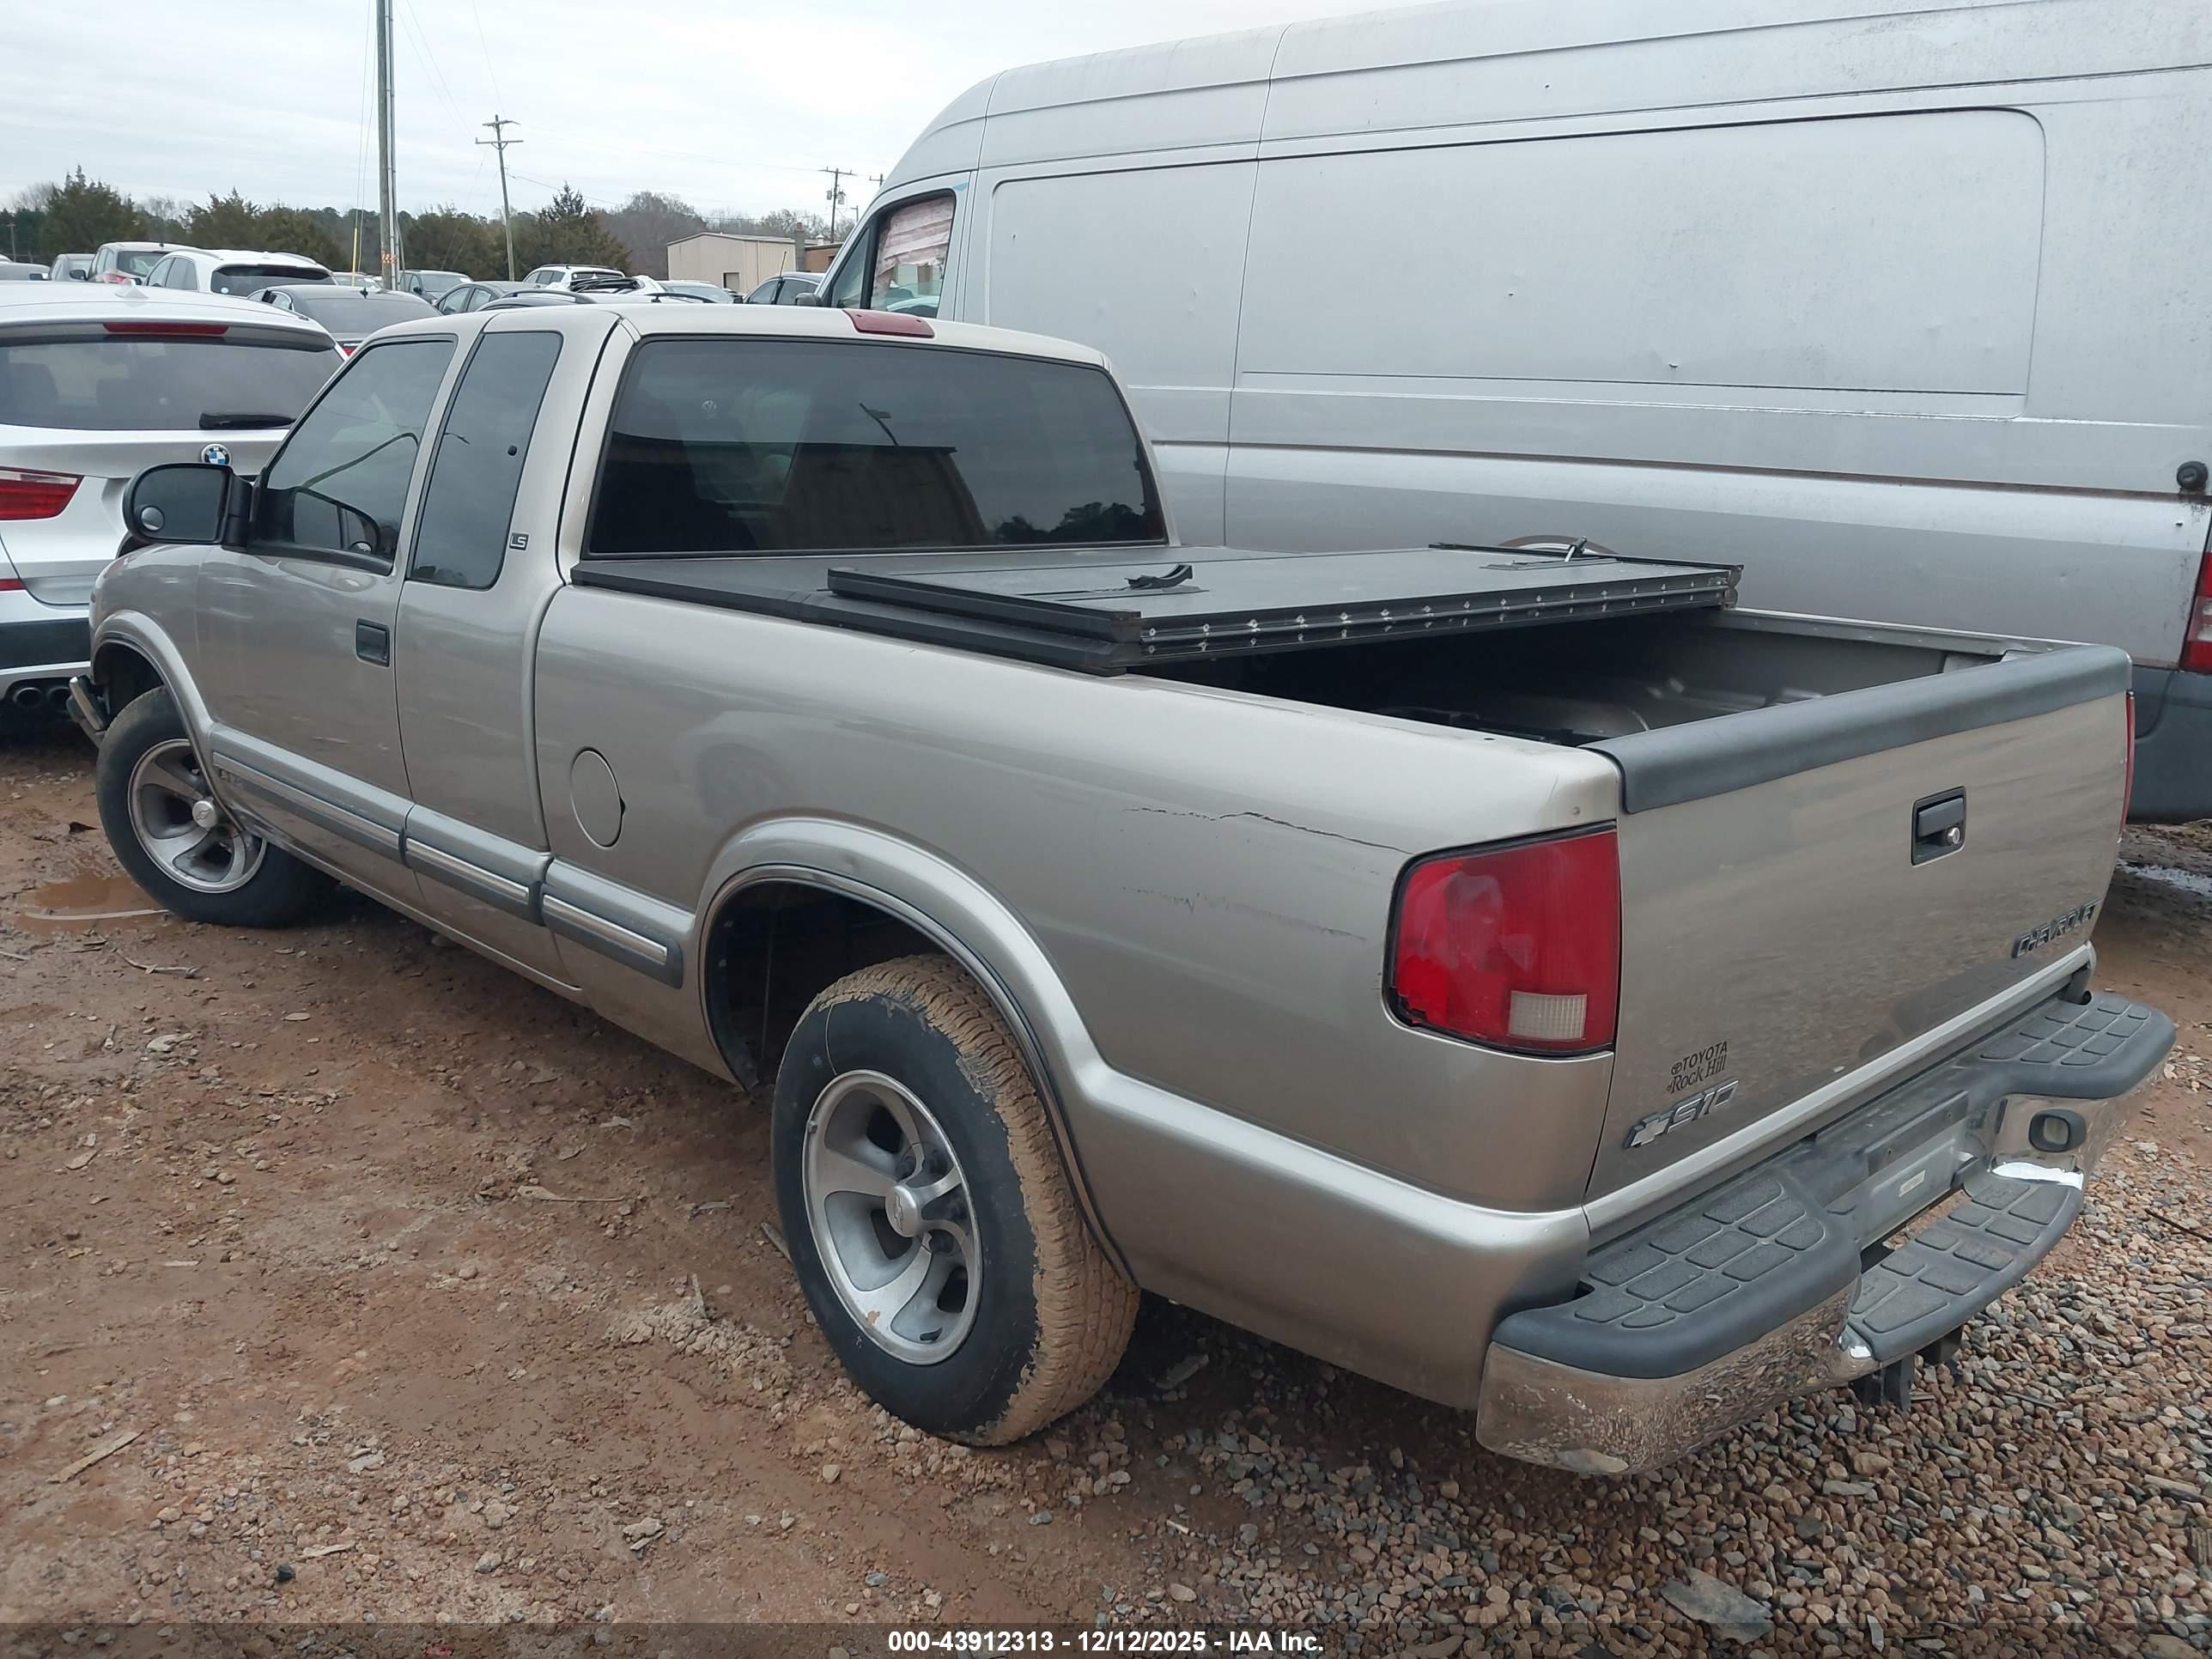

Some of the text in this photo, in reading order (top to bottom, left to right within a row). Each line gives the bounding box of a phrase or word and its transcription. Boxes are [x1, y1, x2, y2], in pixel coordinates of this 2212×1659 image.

[510, 535, 527, 549] LS
[1682, 1041, 1728, 1072] TOYOTA
[1670, 1066, 1705, 1094] Rock
[1705, 1054, 1727, 1079] Hill
